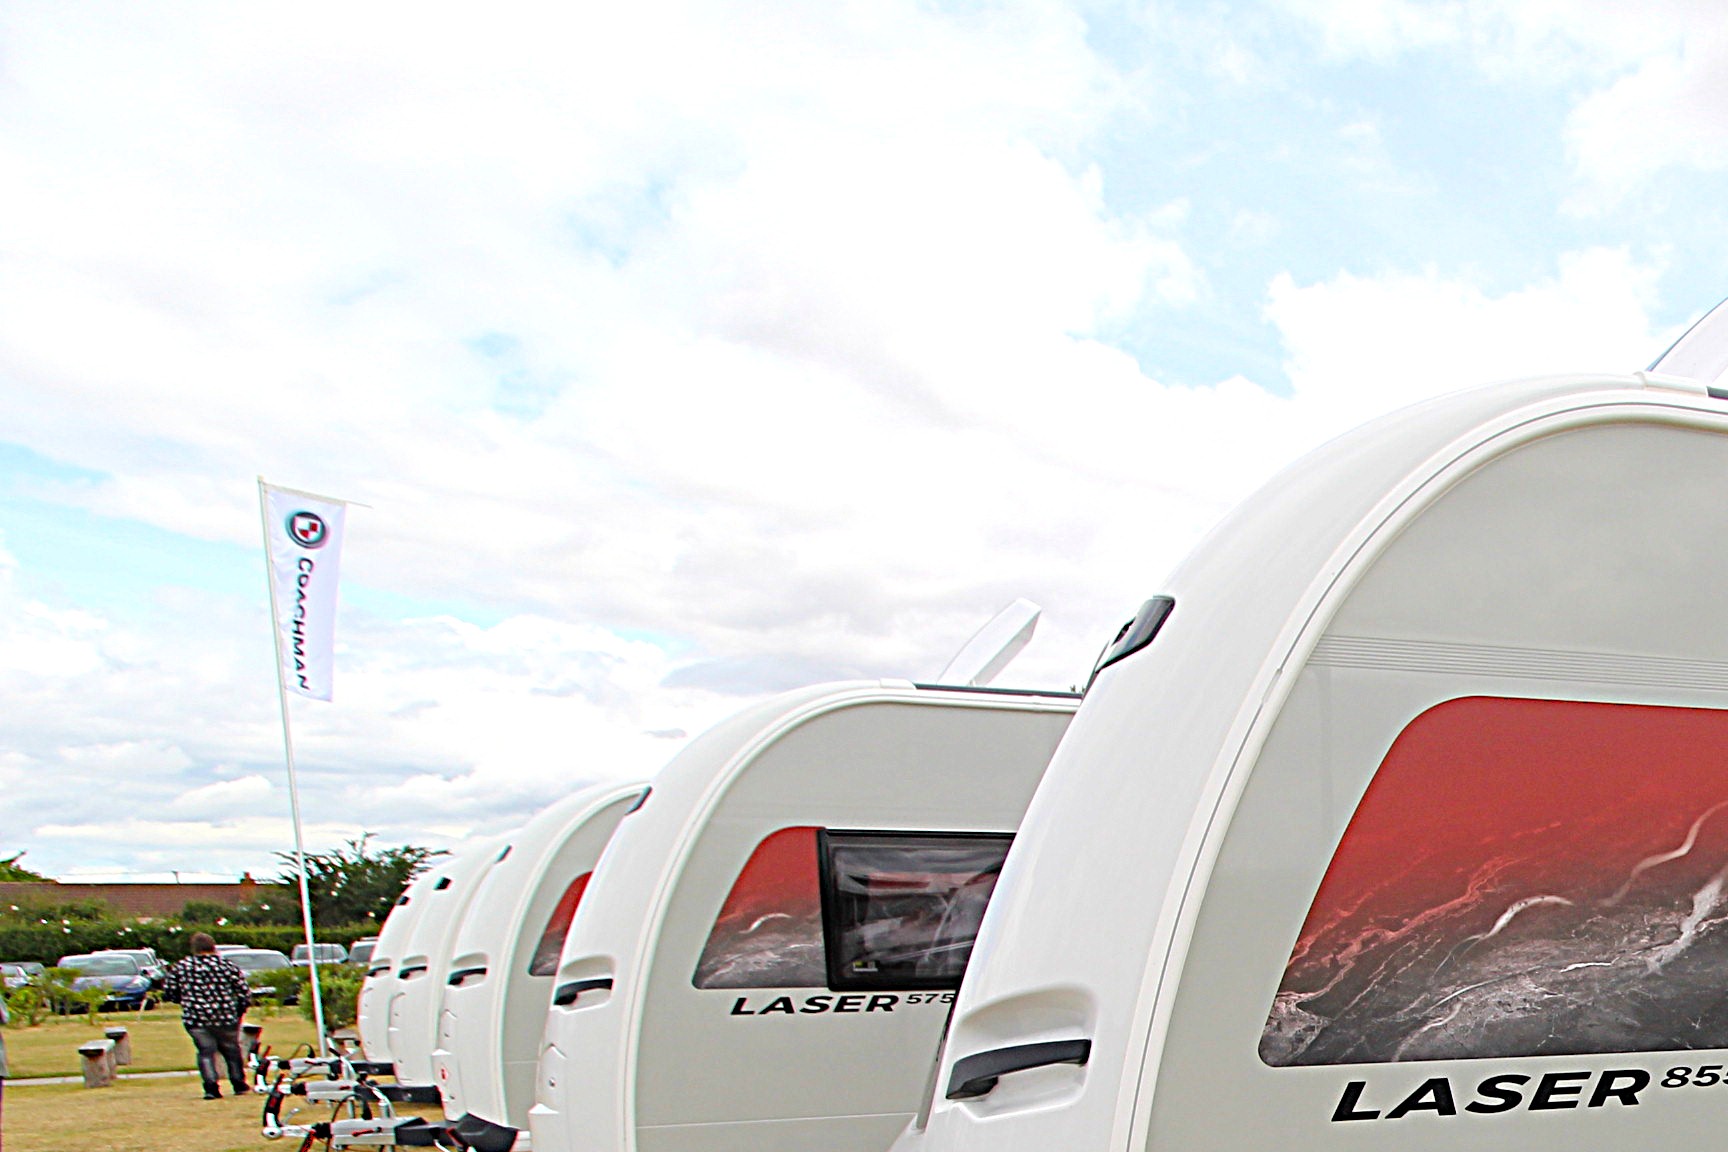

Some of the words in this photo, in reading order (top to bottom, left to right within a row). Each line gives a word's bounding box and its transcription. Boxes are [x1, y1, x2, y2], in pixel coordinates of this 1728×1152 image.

[293, 558, 314, 690] COACHMAN
[731, 995, 899, 1015] LASER
[906, 993, 955, 1005] 575
[1331, 1069, 1651, 1122] LASER
